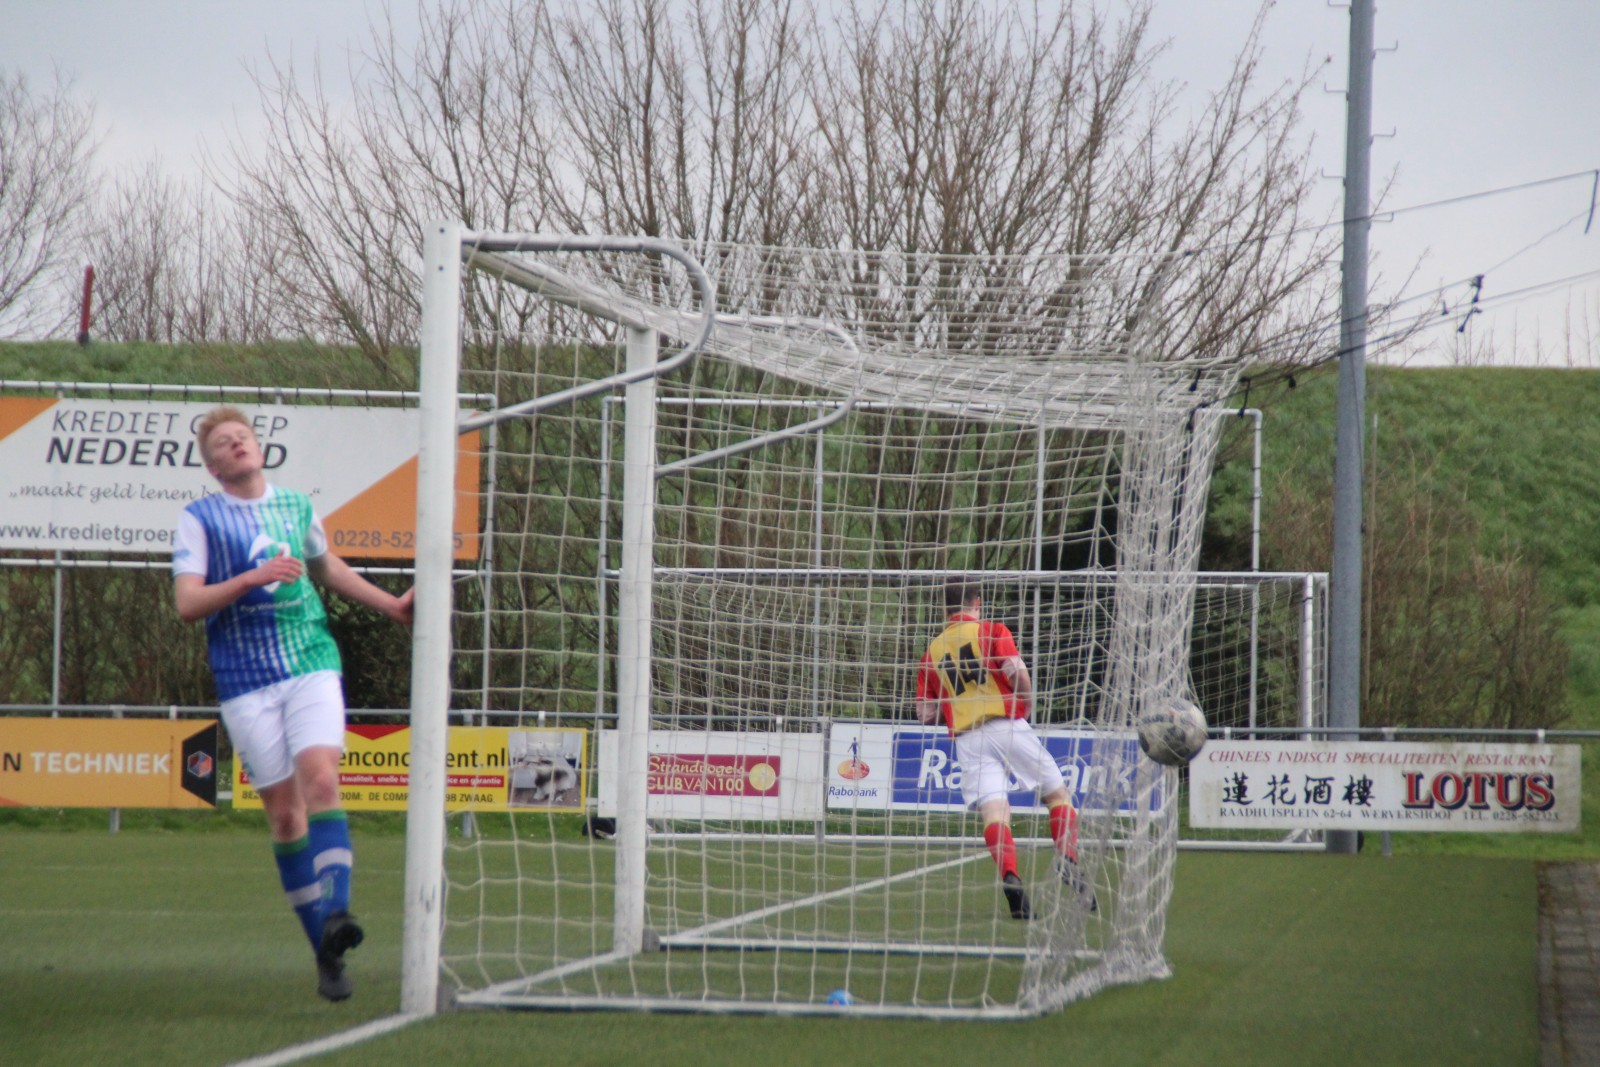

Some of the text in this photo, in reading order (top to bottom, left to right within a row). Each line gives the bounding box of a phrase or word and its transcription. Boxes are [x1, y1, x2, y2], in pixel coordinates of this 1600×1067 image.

[52, 409, 289, 438] KREDIET GEP
[45, 437, 288, 470] NEDERLD
[89, 482, 135, 503] geld
[139, 483, 198, 500] lenen
[333, 529, 463, 549] 0228-525
[937, 641, 988, 697] 14
[30, 752, 170, 775] TECHNIEK
[1208, 750, 1557, 766] CHINEES INDISCH SPECIALITEITEN RESTAURANT
[470, 777, 502, 787] garantie
[1221, 771, 1376, 808] 蓮花酒樓
[1401, 770, 1556, 812] LOTUS
[368, 792, 380, 801] DE
[1219, 807, 1320, 819] RAADHUISPLEIN
[1323, 809, 1353, 819] 62-64
[1360, 809, 1454, 820] WERVERSHOOF
